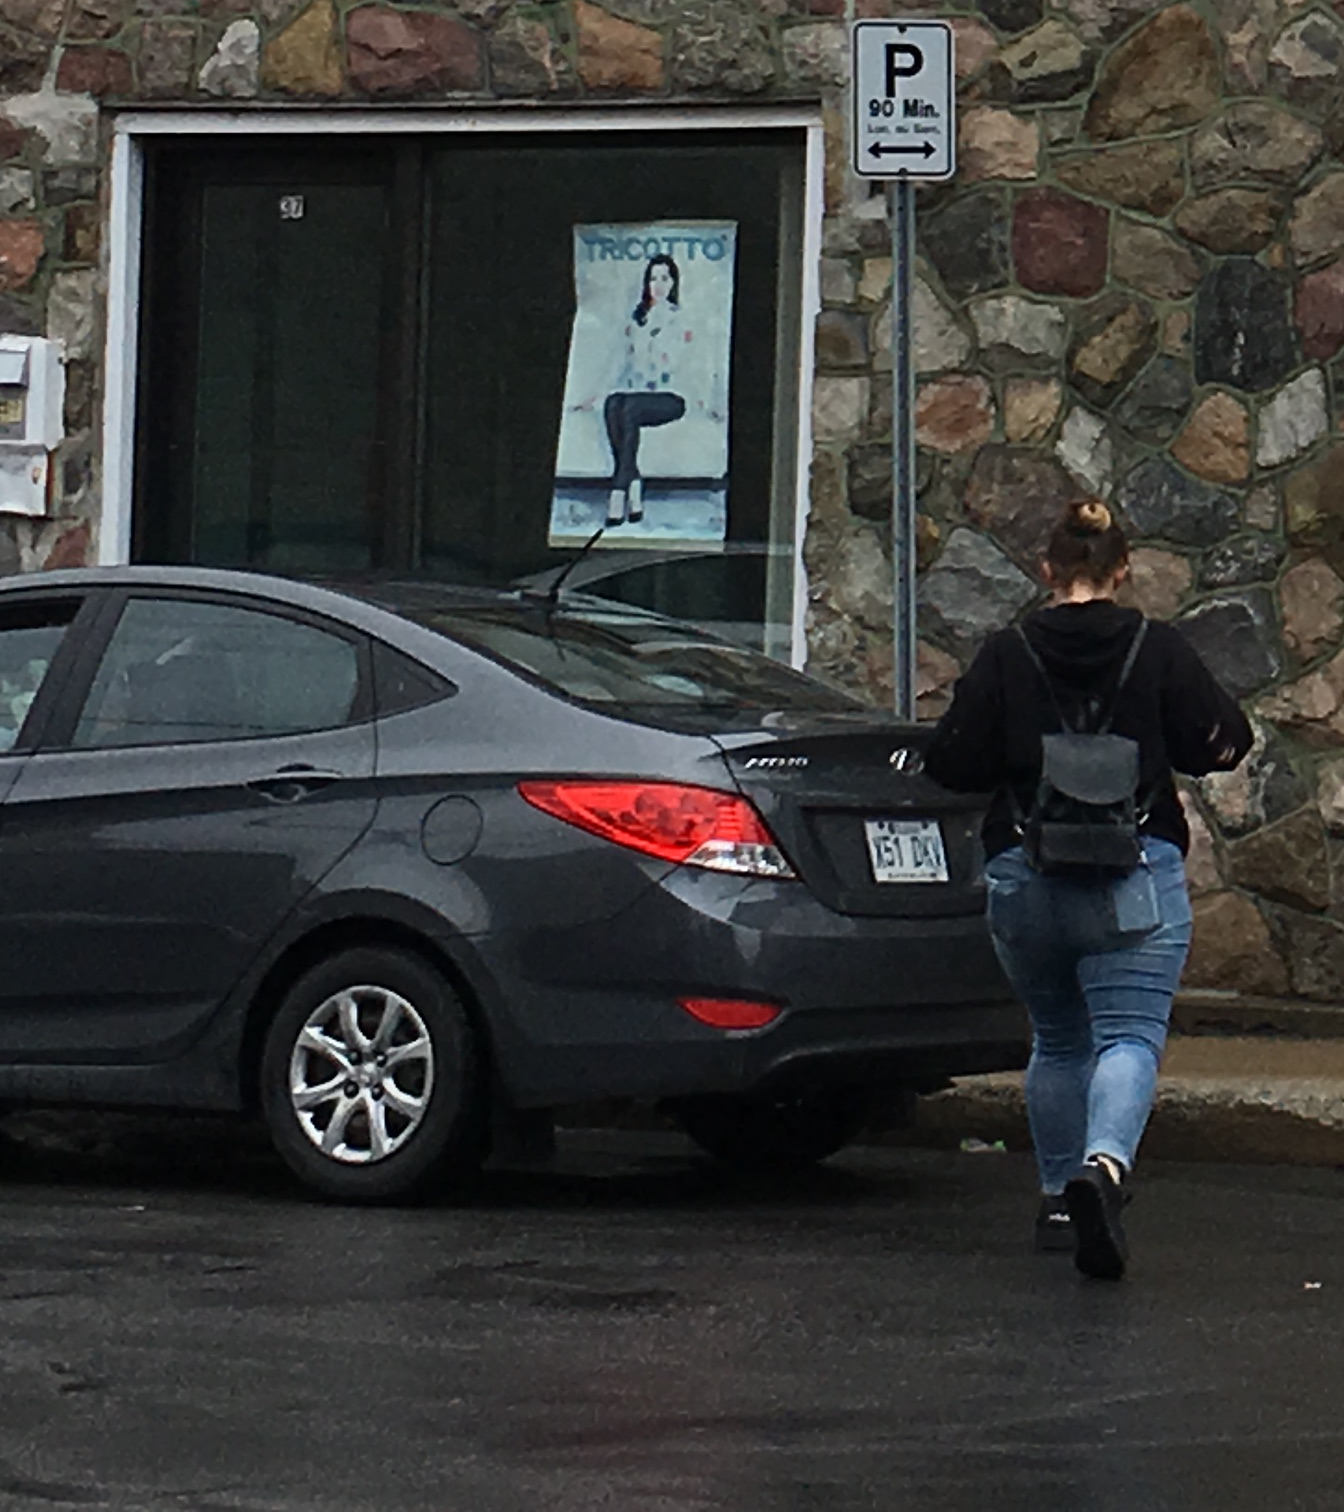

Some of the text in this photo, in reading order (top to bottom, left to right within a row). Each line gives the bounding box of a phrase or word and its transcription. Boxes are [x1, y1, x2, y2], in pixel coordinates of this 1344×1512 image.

[885, 43, 924, 98] P
[869, 99, 940, 118] 90 Min.
[581, 236, 726, 262] TRICOTTO
